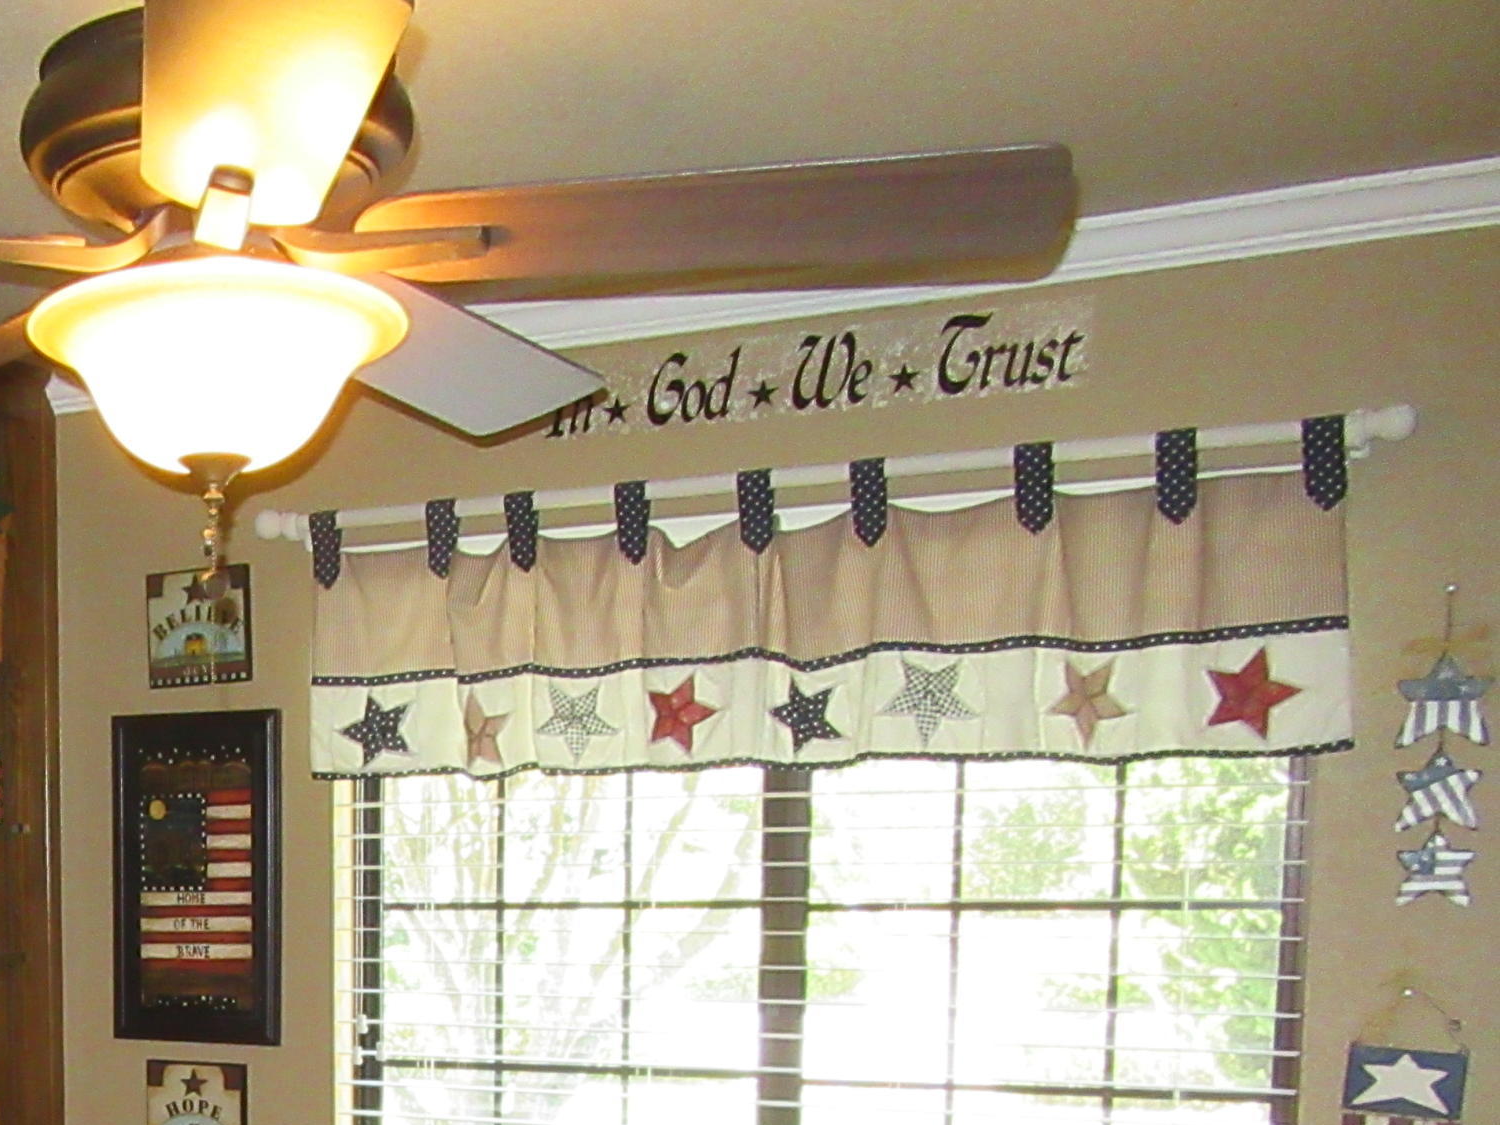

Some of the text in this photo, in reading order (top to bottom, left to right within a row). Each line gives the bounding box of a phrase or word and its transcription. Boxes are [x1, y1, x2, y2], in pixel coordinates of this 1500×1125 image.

[647, 345, 742, 426] God
[792, 331, 873, 410] We
[938, 312, 1085, 395] Trust
[177, 893, 205, 905] HOME
[173, 919, 209, 930] OF THE
[177, 945, 210, 960] BRAVE
[165, 1099, 222, 1121] HOPE
